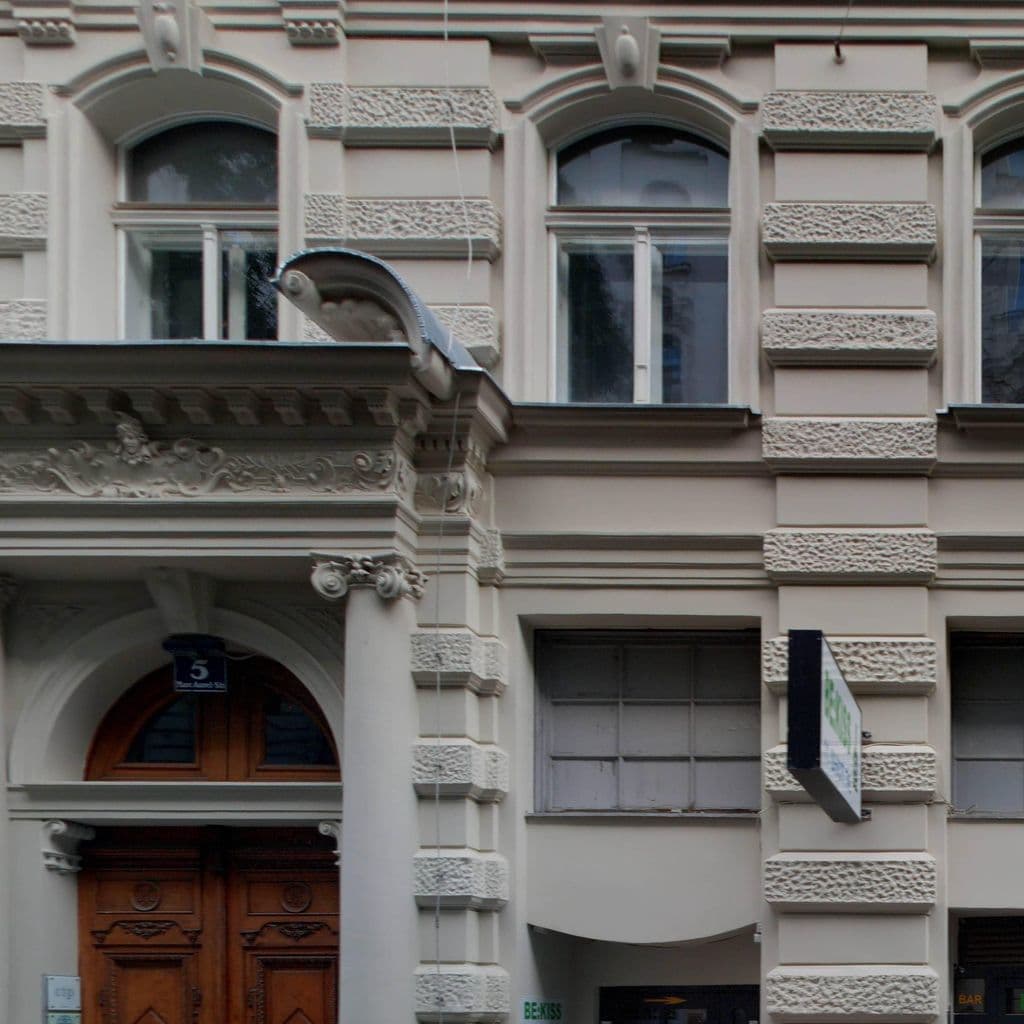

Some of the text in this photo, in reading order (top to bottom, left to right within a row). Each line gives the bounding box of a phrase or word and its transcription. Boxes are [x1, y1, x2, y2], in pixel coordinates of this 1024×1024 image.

[190, 659, 209, 680] 5
[959, 994, 983, 1006] BAR
[524, 1001, 562, 1020] BE:KISS
